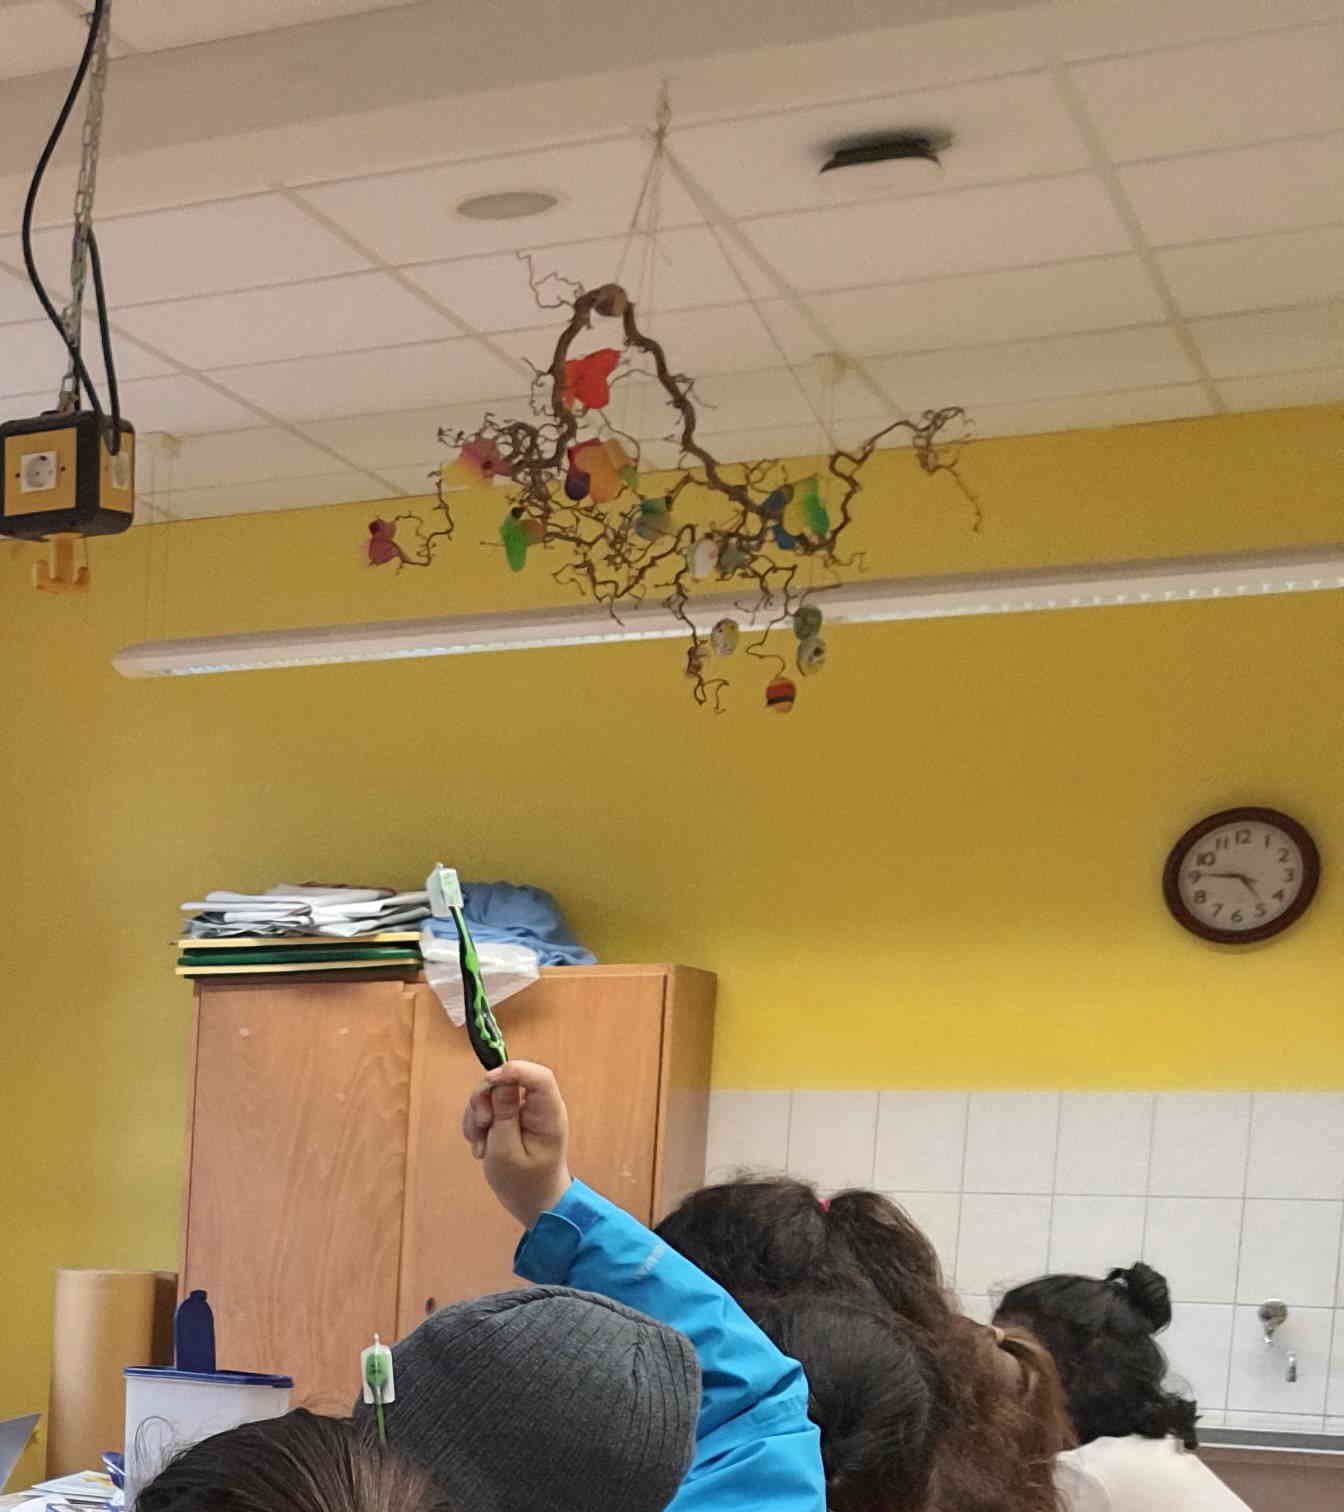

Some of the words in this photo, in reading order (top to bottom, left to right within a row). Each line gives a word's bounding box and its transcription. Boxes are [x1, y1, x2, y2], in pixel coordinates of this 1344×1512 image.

[1215, 836, 1229, 851] 11
[1235, 828, 1252, 845] 12
[1196, 851, 1216, 866] 10
[1277, 848, 1290, 863] 2
[1188, 869, 1202, 884] 9
[1283, 868, 1295, 882] 3
[1194, 889, 1207, 904] 8
[1272, 889, 1284, 901] 4
[1212, 903, 1224, 917] 7
[1231, 909, 1244, 923] 6
[1255, 903, 1267, 917] 5
